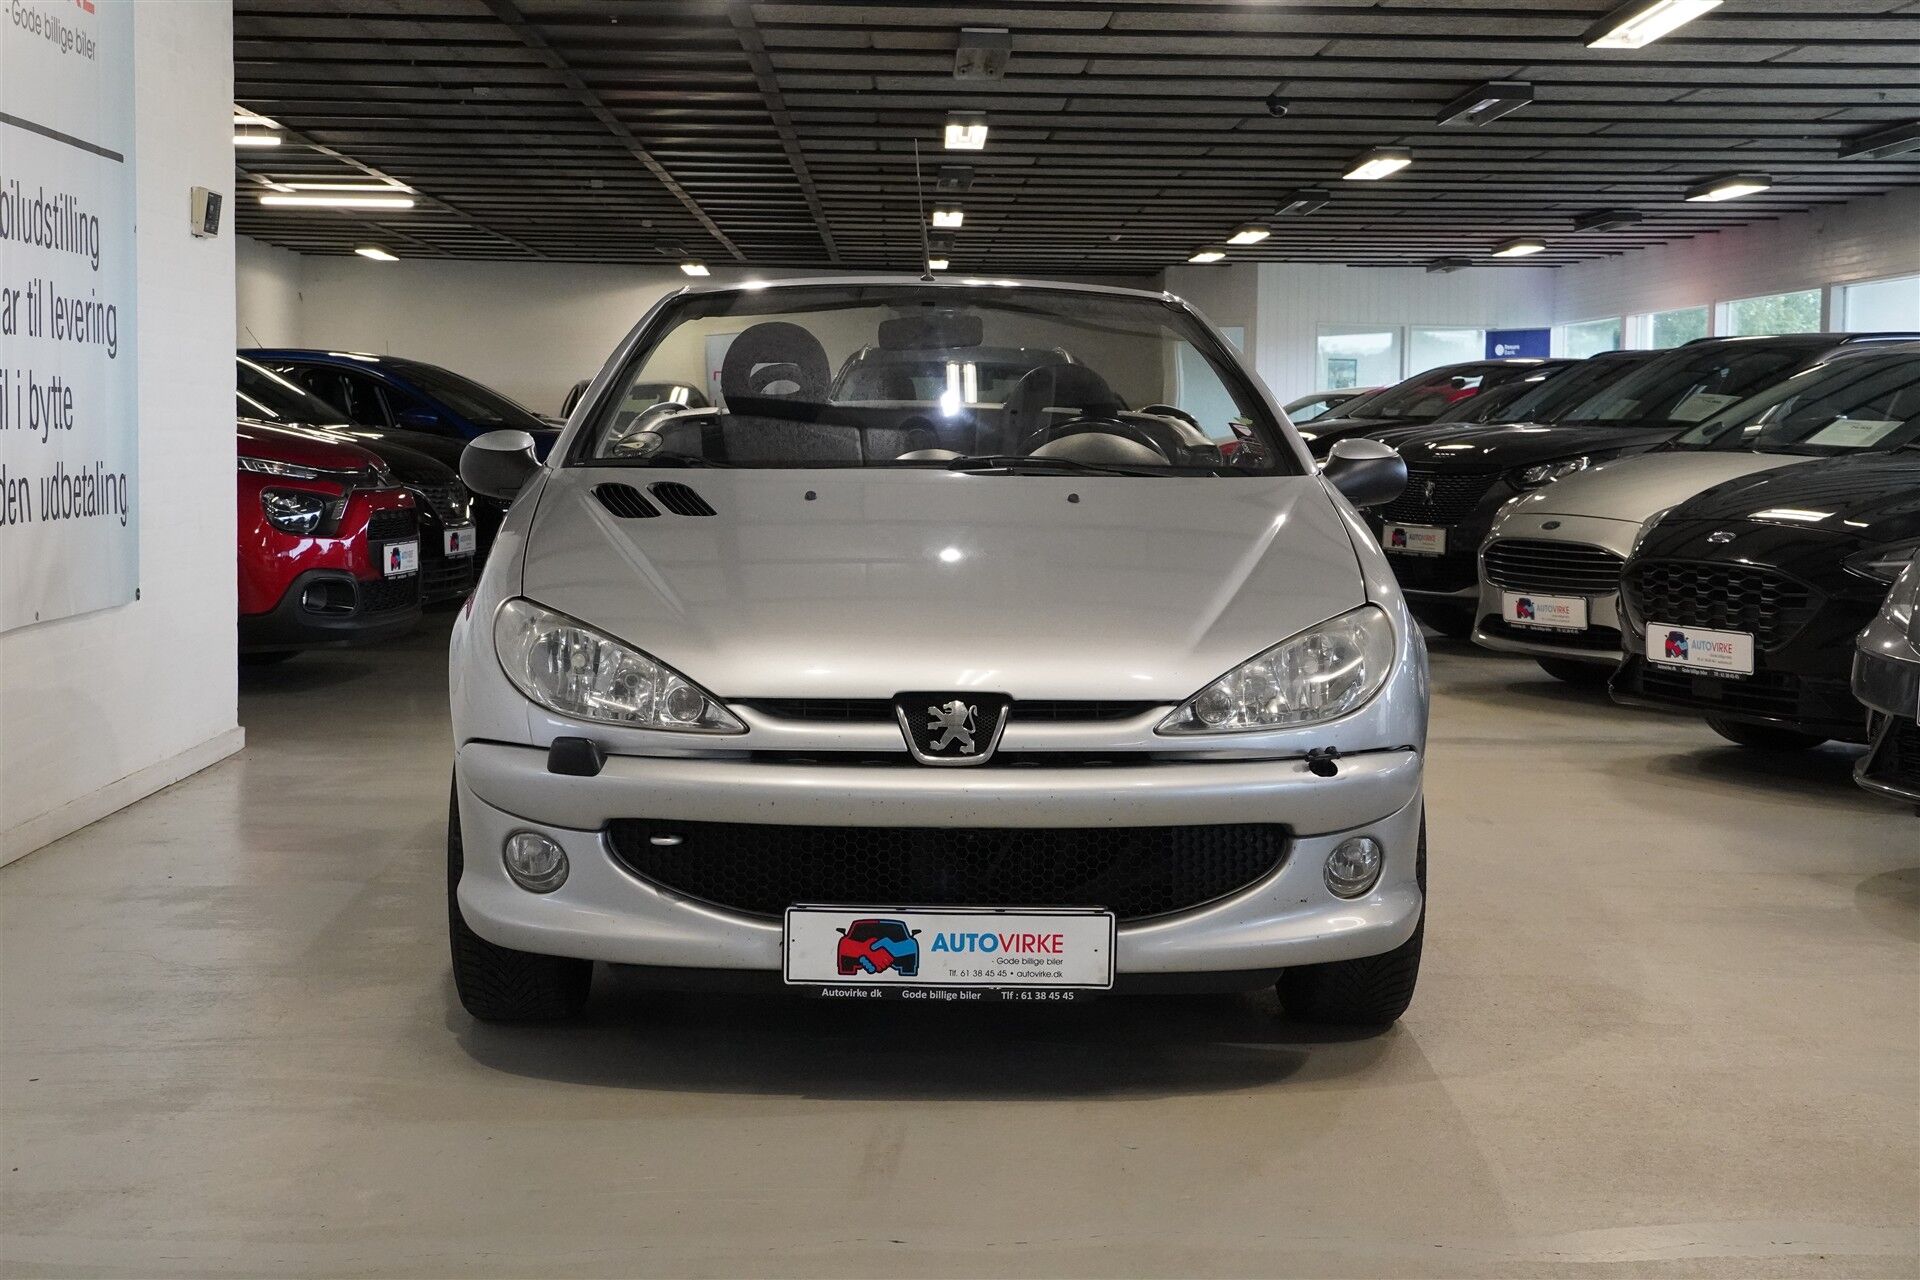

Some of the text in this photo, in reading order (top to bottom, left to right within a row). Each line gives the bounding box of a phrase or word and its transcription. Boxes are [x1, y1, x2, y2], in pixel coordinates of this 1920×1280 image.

[12, 0, 41, 35] Gode
[44, 12, 74, 54] billige
[75, 27, 96, 61] biler
[27, 278, 42, 338] til
[50, 280, 117, 360] levering
[17, 369, 21, 430] i
[29, 369, 73, 444] bytte
[41, 460, 127, 527] udbetaling
[1690, 639, 1733, 654] AUTOVIRKE
[931, 932, 1064, 953] AUTOVIRKE
[996, 957, 1020, 966] Gode
[1022, 957, 1045, 967] billige
[1046, 957, 1064, 966] biler
[985, 970, 995, 978] 45
[997, 970, 1008, 978] 45
[1016, 970, 1064, 978] autovirke.dk
[821, 988, 868, 998] Autovirke
[870, 989, 882, 998] dk
[902, 990, 927, 999] Gode
[929, 990, 958, 1001] billige
[960, 991, 982, 1000] biler
[1001, 991, 1014, 1000] Tlf
[1021, 992, 1032, 1000] 61
[1035, 992, 1046, 1000] 38
[1048, 992, 1060, 1000] 45
[1062, 992, 1074, 1000] 45
